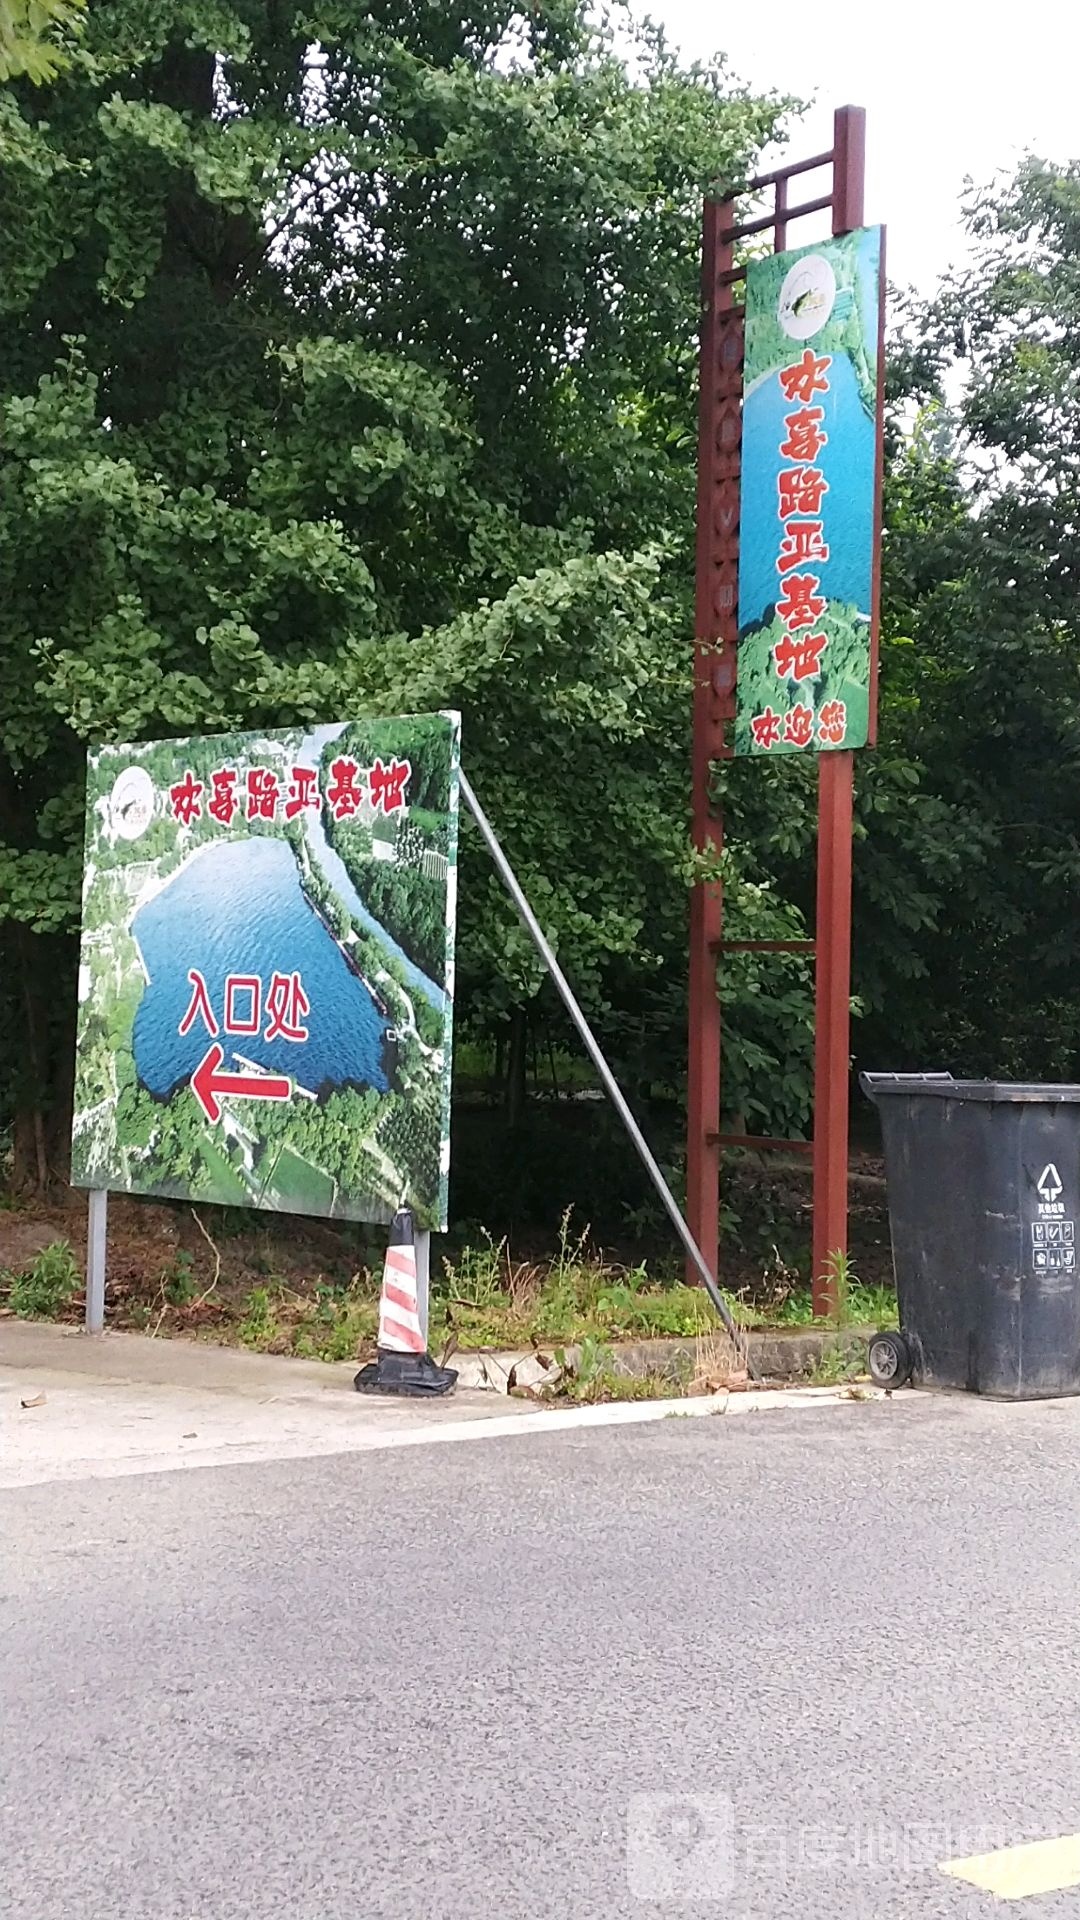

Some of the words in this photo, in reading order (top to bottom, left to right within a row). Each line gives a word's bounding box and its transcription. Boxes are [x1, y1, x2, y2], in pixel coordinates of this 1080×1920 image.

[776, 349, 832, 681] 欢喜路亚基地
[752, 701, 847, 749] 欢迎您
[169, 757, 412, 826] 欢喜路亚基地
[179, 969, 310, 1042] 入口处
